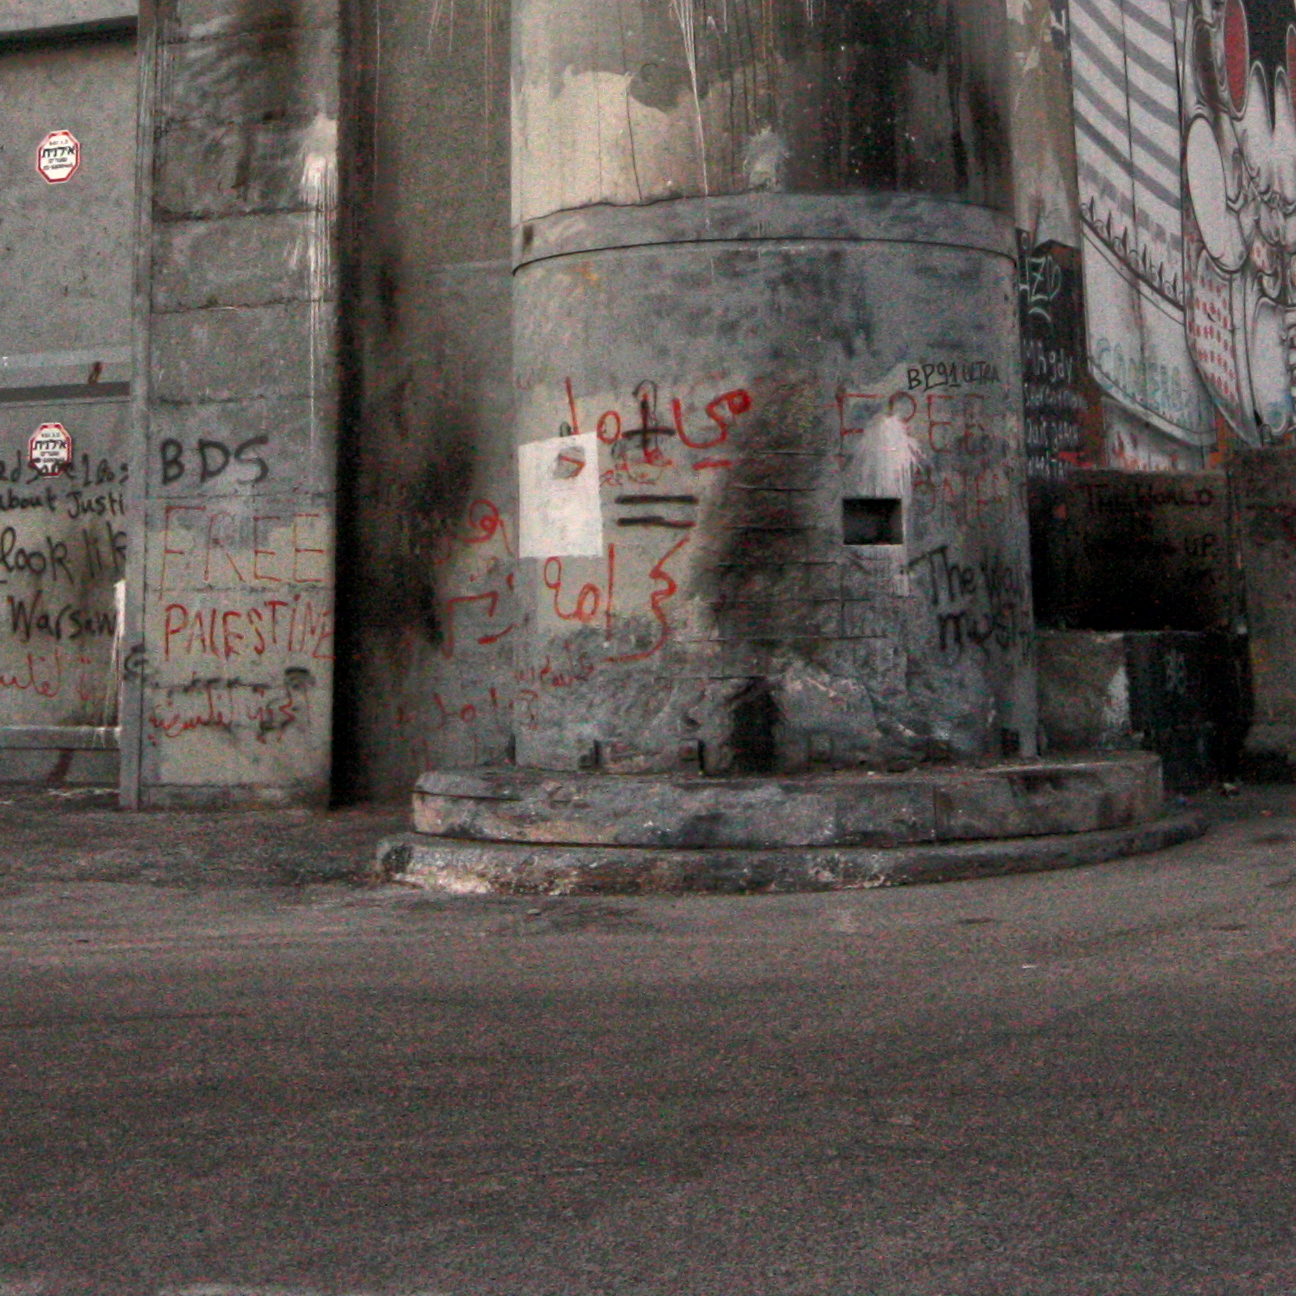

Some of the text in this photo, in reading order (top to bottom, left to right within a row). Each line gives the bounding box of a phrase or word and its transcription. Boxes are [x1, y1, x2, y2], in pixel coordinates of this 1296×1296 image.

[158, 433, 270, 486] BDS
[158, 505, 326, 600] FREE
[163, 593, 336, 662] PALESTINE
